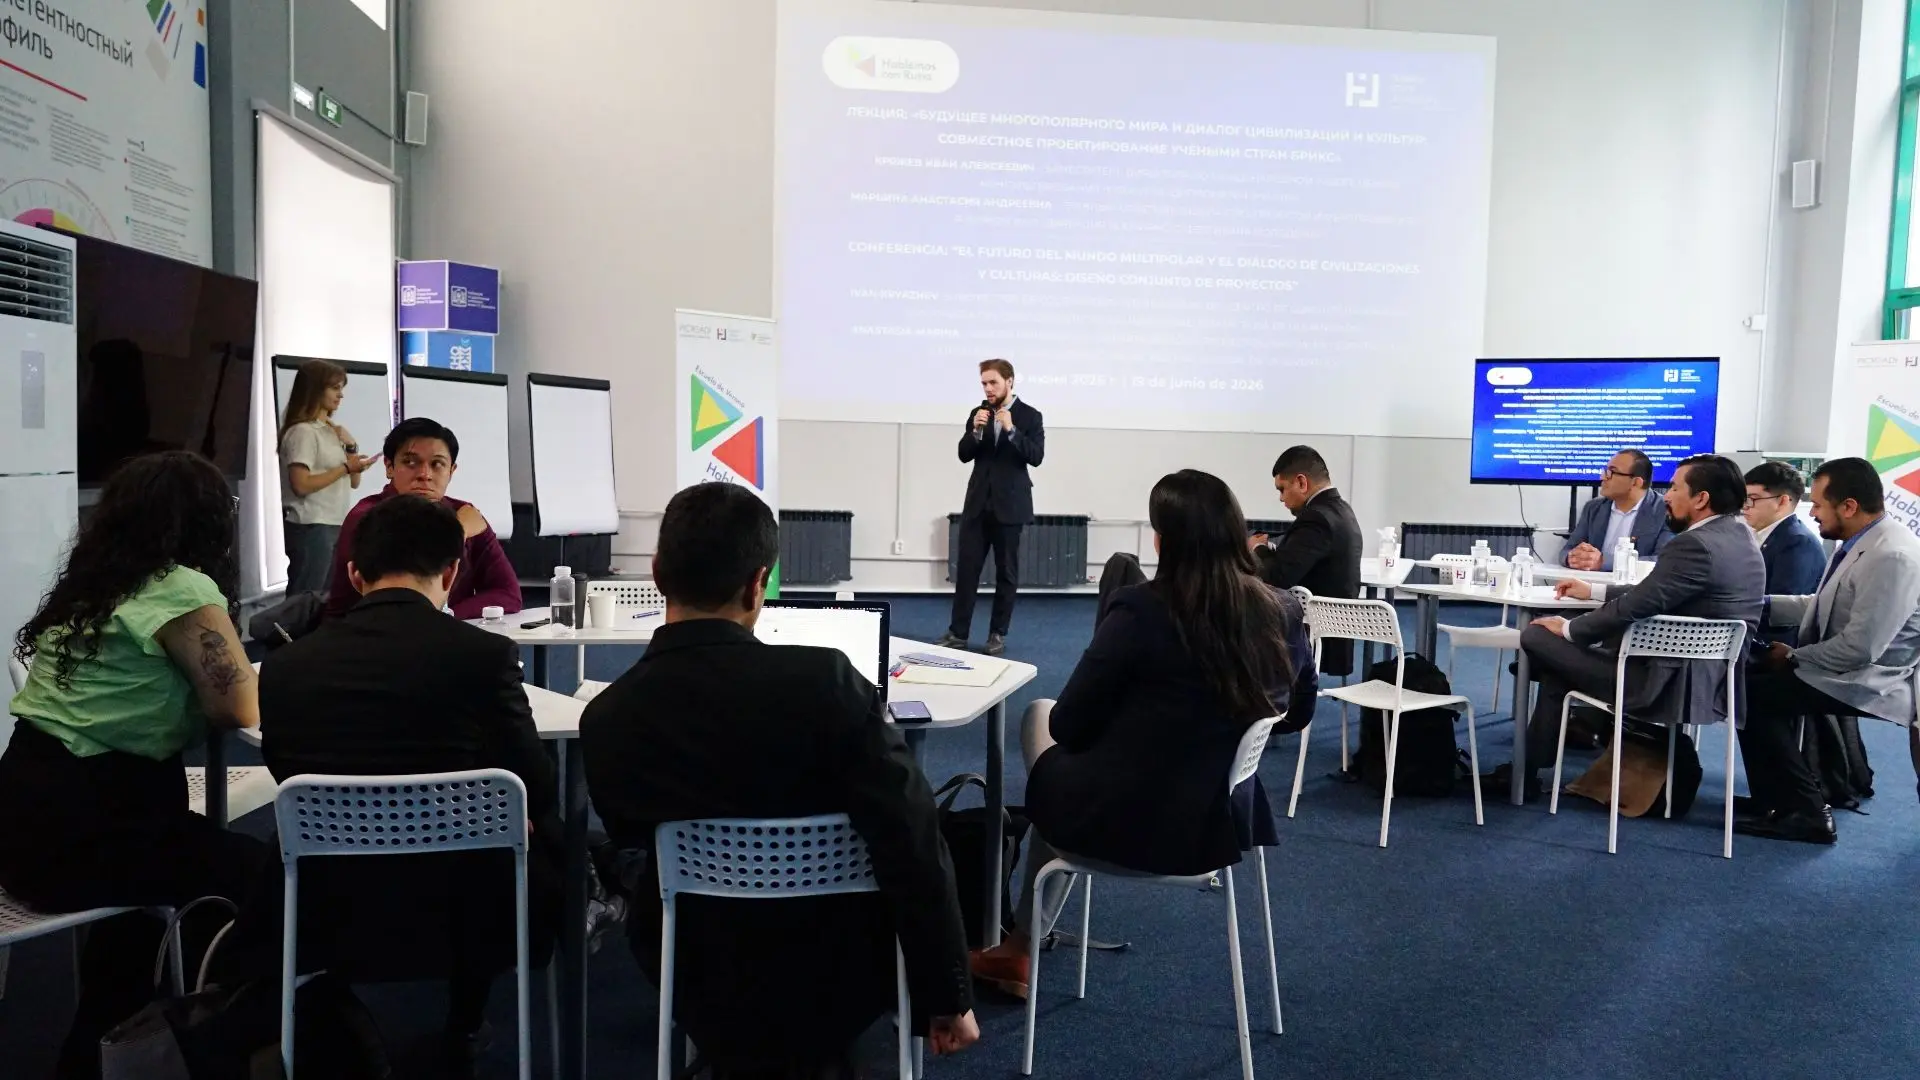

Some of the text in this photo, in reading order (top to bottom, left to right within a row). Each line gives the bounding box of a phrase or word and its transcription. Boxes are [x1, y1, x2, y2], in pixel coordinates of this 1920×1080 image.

[0, 15, 53, 59] филь
[846, 106, 908, 120] ЛЕКЦИЯ:
[990, 113, 1125, 131] МНОГОПОЛЯРНОГО
[1128, 120, 1169, 132] МИРА
[1172, 122, 1182, 133] И
[1184, 123, 1242, 137] ДИАЛОГ
[937, 132, 1034, 149] СОВМЕСТНОЕ
[1036, 137, 1168, 155] ПРОЕКТИРОВАНИЕ
[1244, 148, 1288, 160] СТРАН
[978, 247, 1032, 259] FUTURO
[1034, 248, 1064, 261] DEL
[1065, 250, 1118, 263] MUNDO
[1120, 252, 1204, 267] MULTIPOLAR
[1217, 256, 1235, 267] EL
[1299, 259, 1319, 271] DE
[1320, 259, 1421, 275] CIVILIZACIONES
[978, 268, 988, 281] Y
[1118, 274, 1192, 288] CONJUNTO
[1194, 277, 1214, 289] DE
[1148, 374, 1166, 388] de
[1167, 376, 1207, 391] junio
[1209, 378, 1228, 391] de
[1230, 379, 1265, 392] 2026
